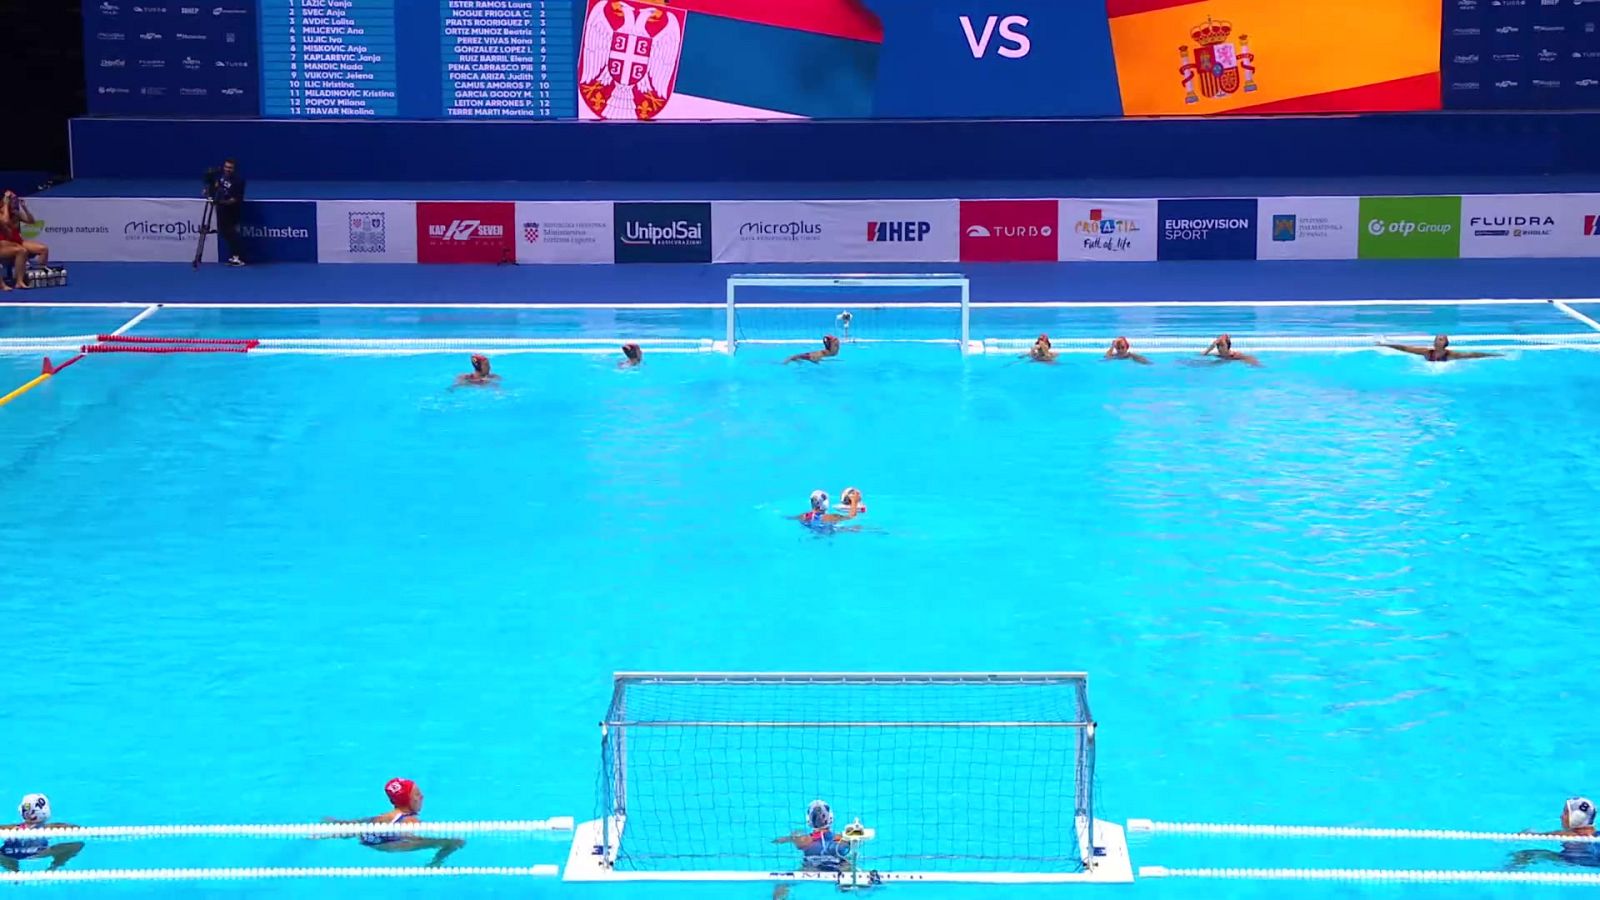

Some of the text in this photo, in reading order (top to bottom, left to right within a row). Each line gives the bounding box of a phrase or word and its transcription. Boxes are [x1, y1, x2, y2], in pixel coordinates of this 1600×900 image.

[327, 0, 352, 8] Vanja
[326, 9, 346, 17] Anja
[959, 15, 1031, 58] VS
[347, 45, 367, 53] Anja
[357, 54, 381, 63] Janja
[1470, 216, 1555, 226] FLUIDRA
[242, 226, 308, 238] Malmsten
[429, 224, 446, 235] KAP
[478, 224, 503, 235] SEVEN
[626, 220, 702, 245] UnipolSai
[889, 221, 931, 241] HEP
[993, 226, 1052, 236] TURBO
[1075, 220, 1140, 234] CROATIA
[1389, 220, 1451, 237] otp Group
[1165, 229, 1208, 240] SPORT
[35, 798, 46, 810] 10
[1579, 801, 1590, 812] 8
